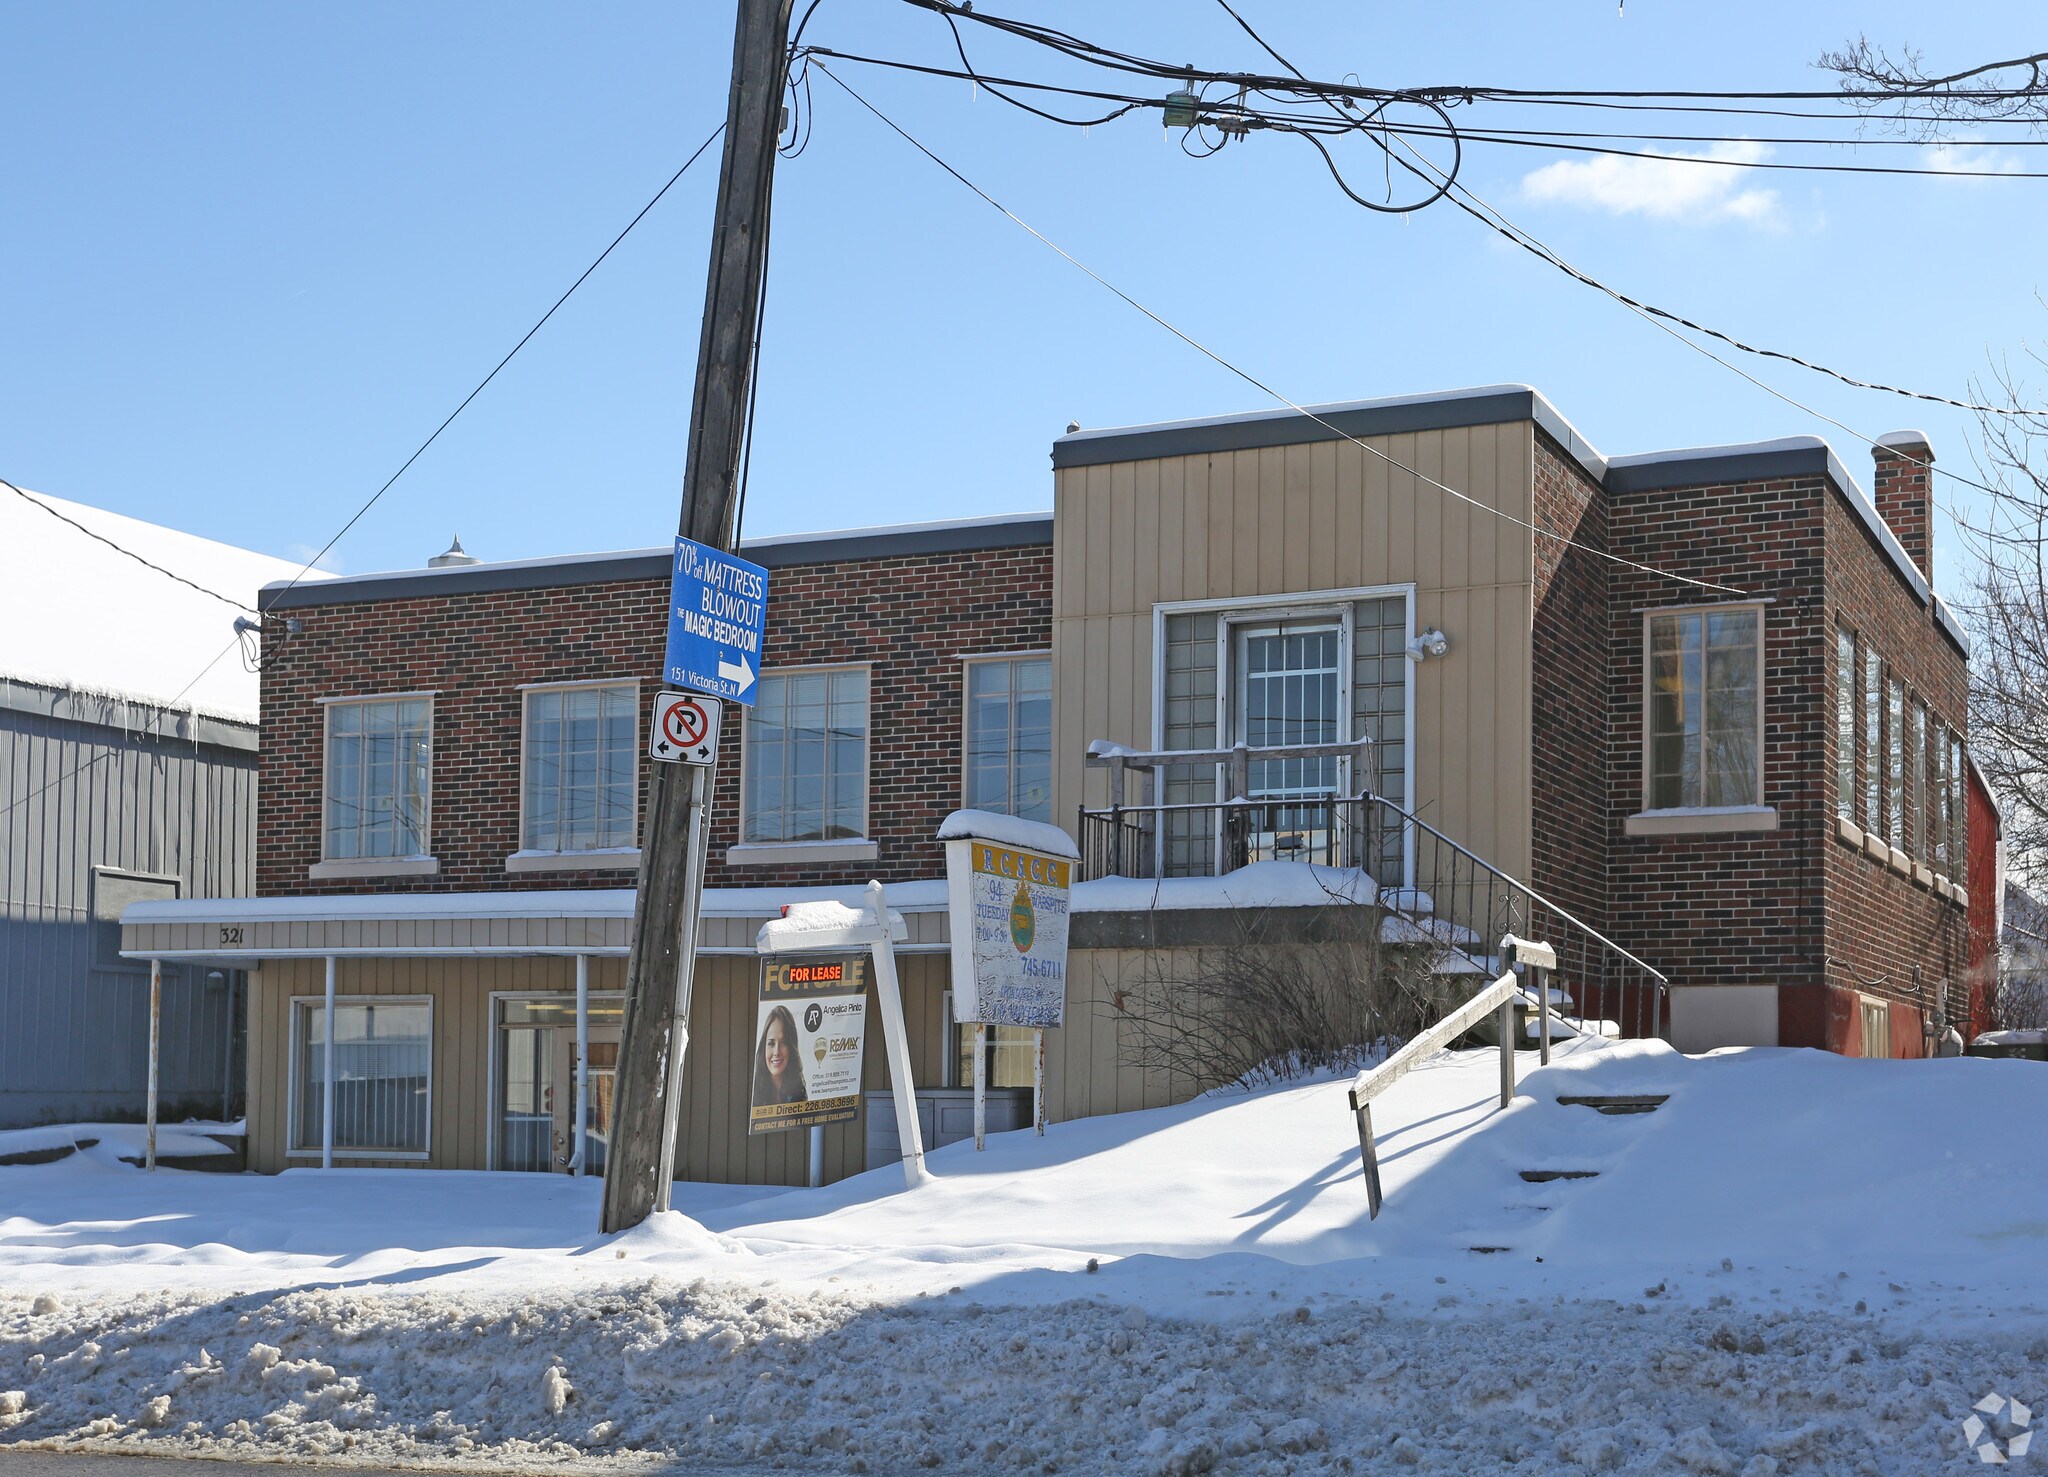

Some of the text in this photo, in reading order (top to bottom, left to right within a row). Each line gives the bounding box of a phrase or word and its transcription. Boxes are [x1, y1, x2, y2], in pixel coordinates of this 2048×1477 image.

[703, 557, 762, 600] MATTRESS
[677, 607, 685, 618] THE
[701, 586, 761, 628] BLOWOUT
[684, 610, 758, 653] MAGIC BEDROOM
[671, 666, 686, 682] 151
[688, 671, 719, 691] Victoria
[975, 902, 1010, 922] TUESDAY
[221, 927, 244, 944] 321
[790, 966, 841, 982] FOR LEASE
[823, 1004, 848, 1016] Angelica
[776, 1104, 803, 1115] Direct:
